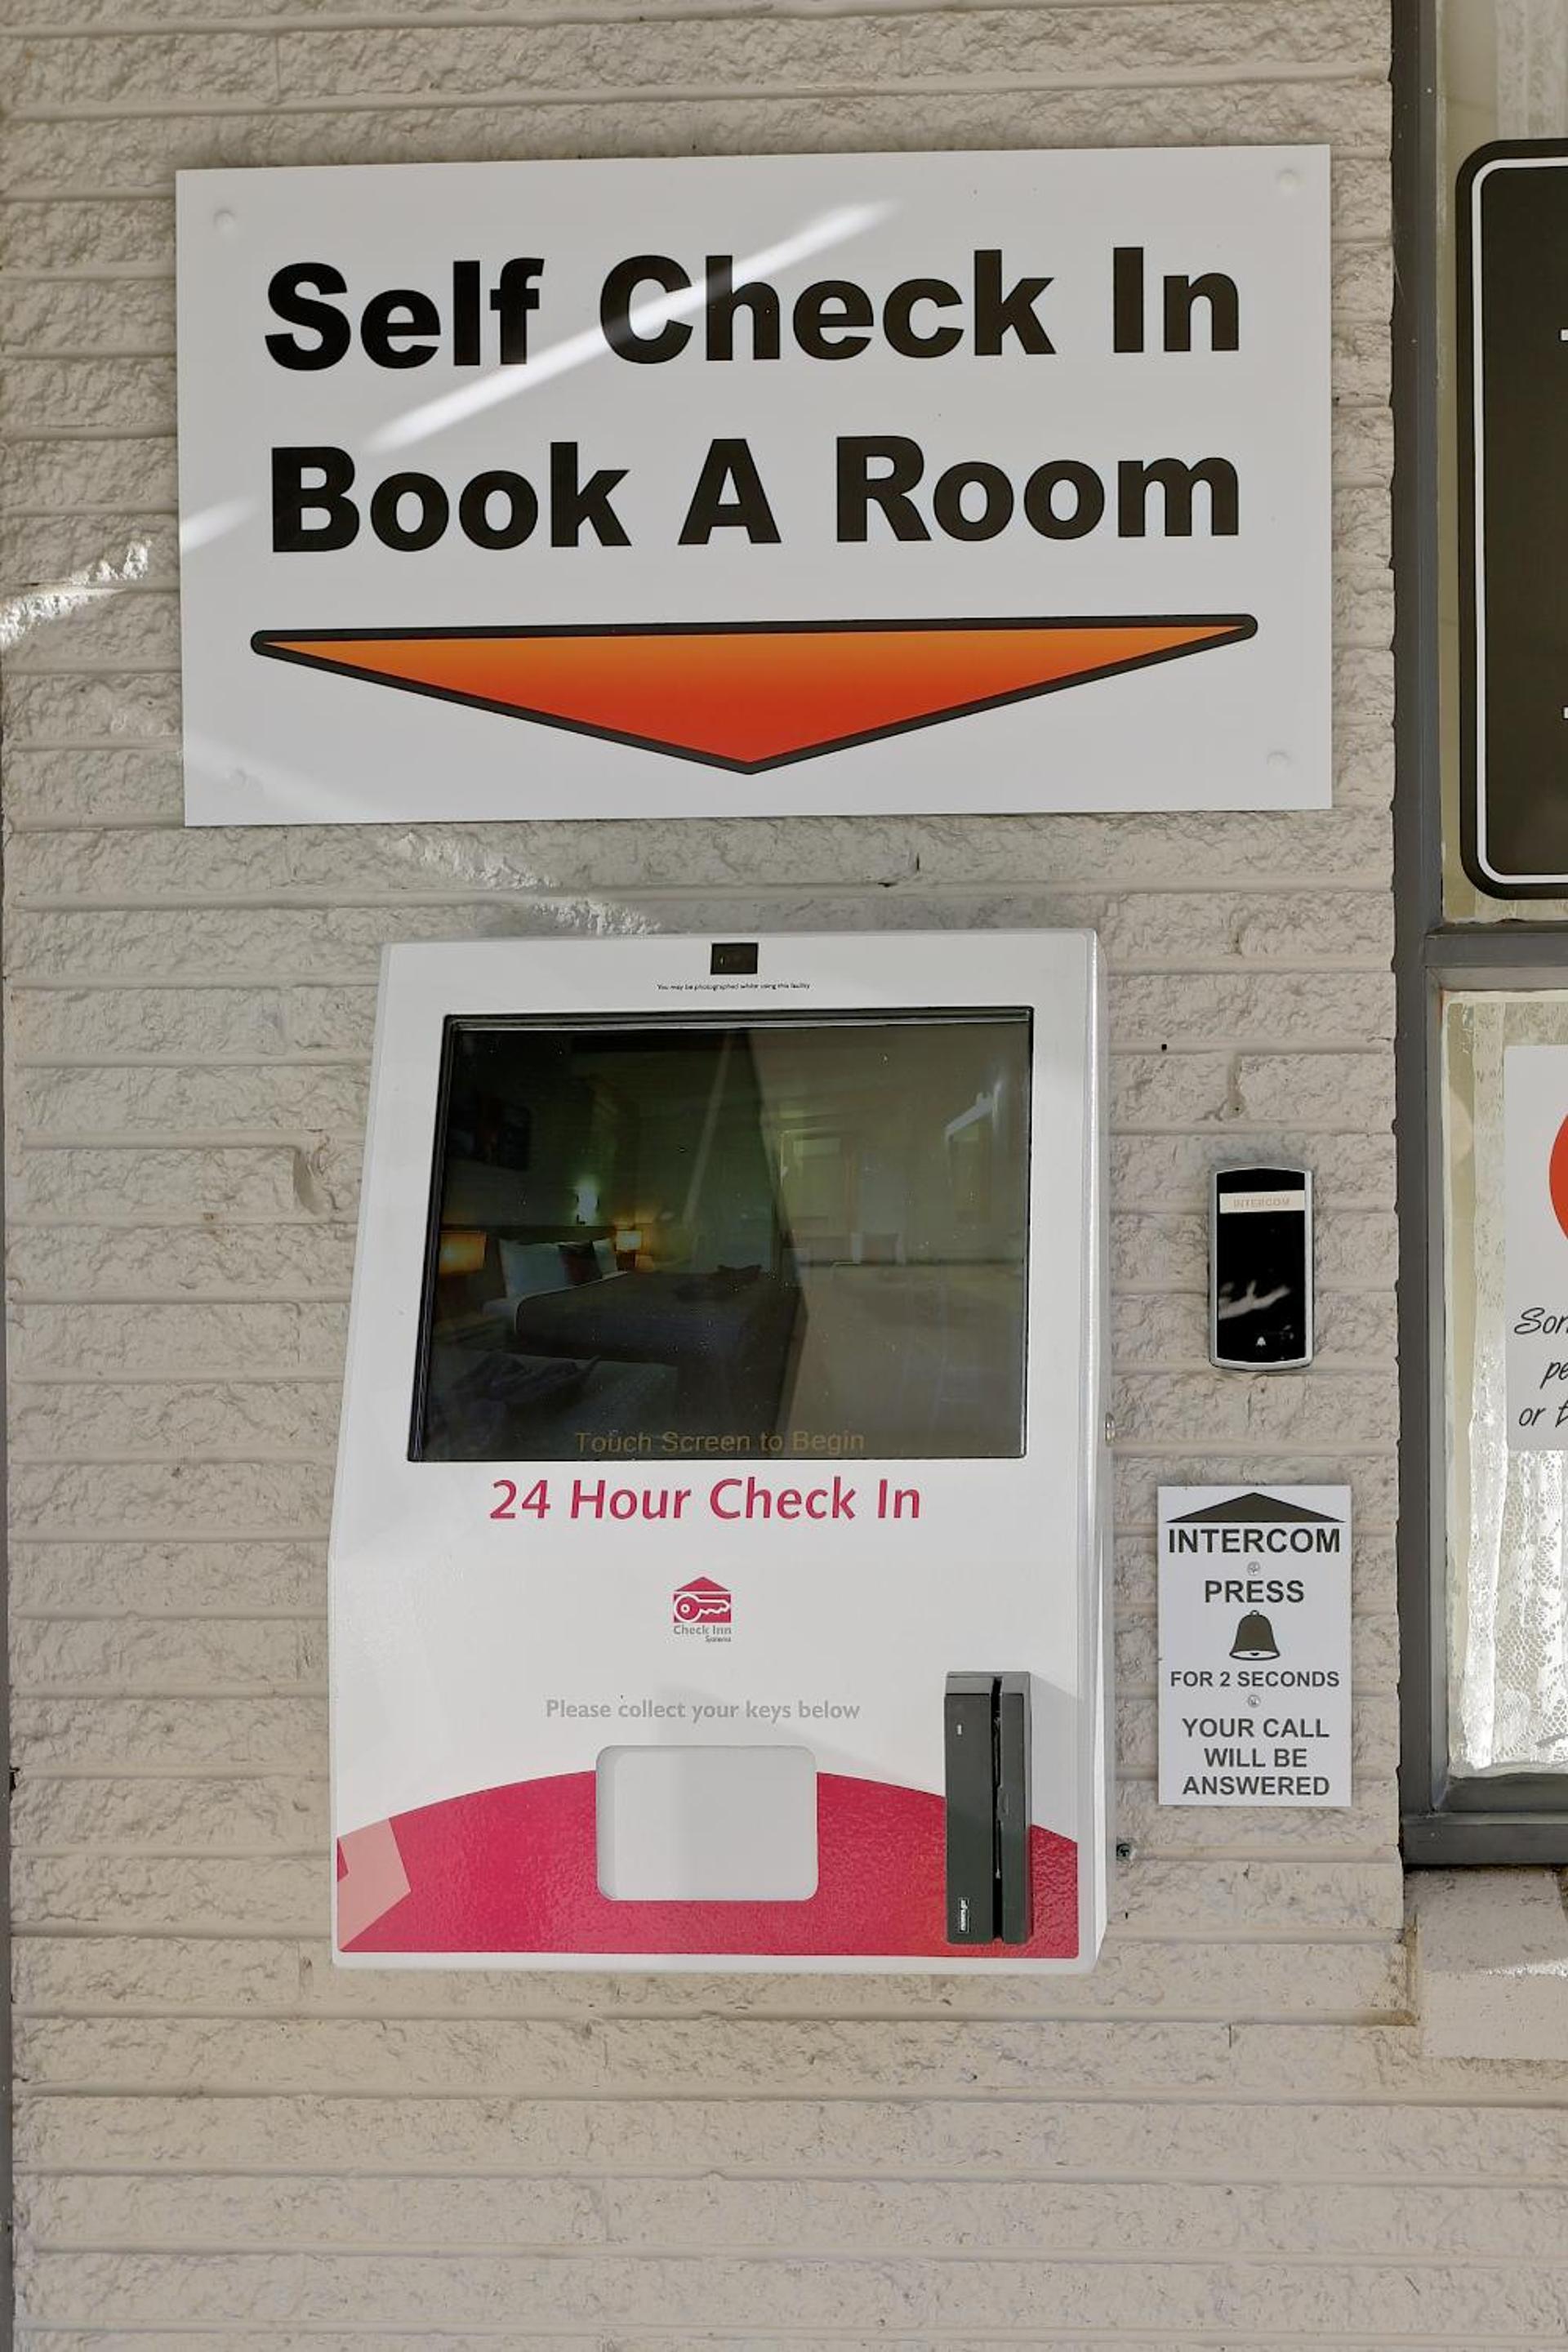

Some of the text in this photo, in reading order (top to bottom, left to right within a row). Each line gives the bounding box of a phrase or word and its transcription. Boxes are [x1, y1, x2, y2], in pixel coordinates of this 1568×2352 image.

[265, 247, 1240, 371] Self Check In
[271, 435, 1239, 553] Book A Room
[1519, 1408, 1546, 1426] or
[577, 1431, 864, 1455] Touch Screen to Begin
[490, 1476, 920, 1519] 24 Hour Check In
[1169, 1528, 1340, 1553] INTERCOM
[1205, 1579, 1304, 1603] PRESS
[674, 1624, 732, 1635] Check Inn
[1170, 1671, 1340, 1687] FOR 2 SECONDS
[546, 1699, 861, 1725] Please collect your keys below
[1182, 1717, 1330, 1738] YOUR CALL
[1204, 1748, 1307, 1768] WILL BE
[1182, 1775, 1330, 1796] ANSWERED
